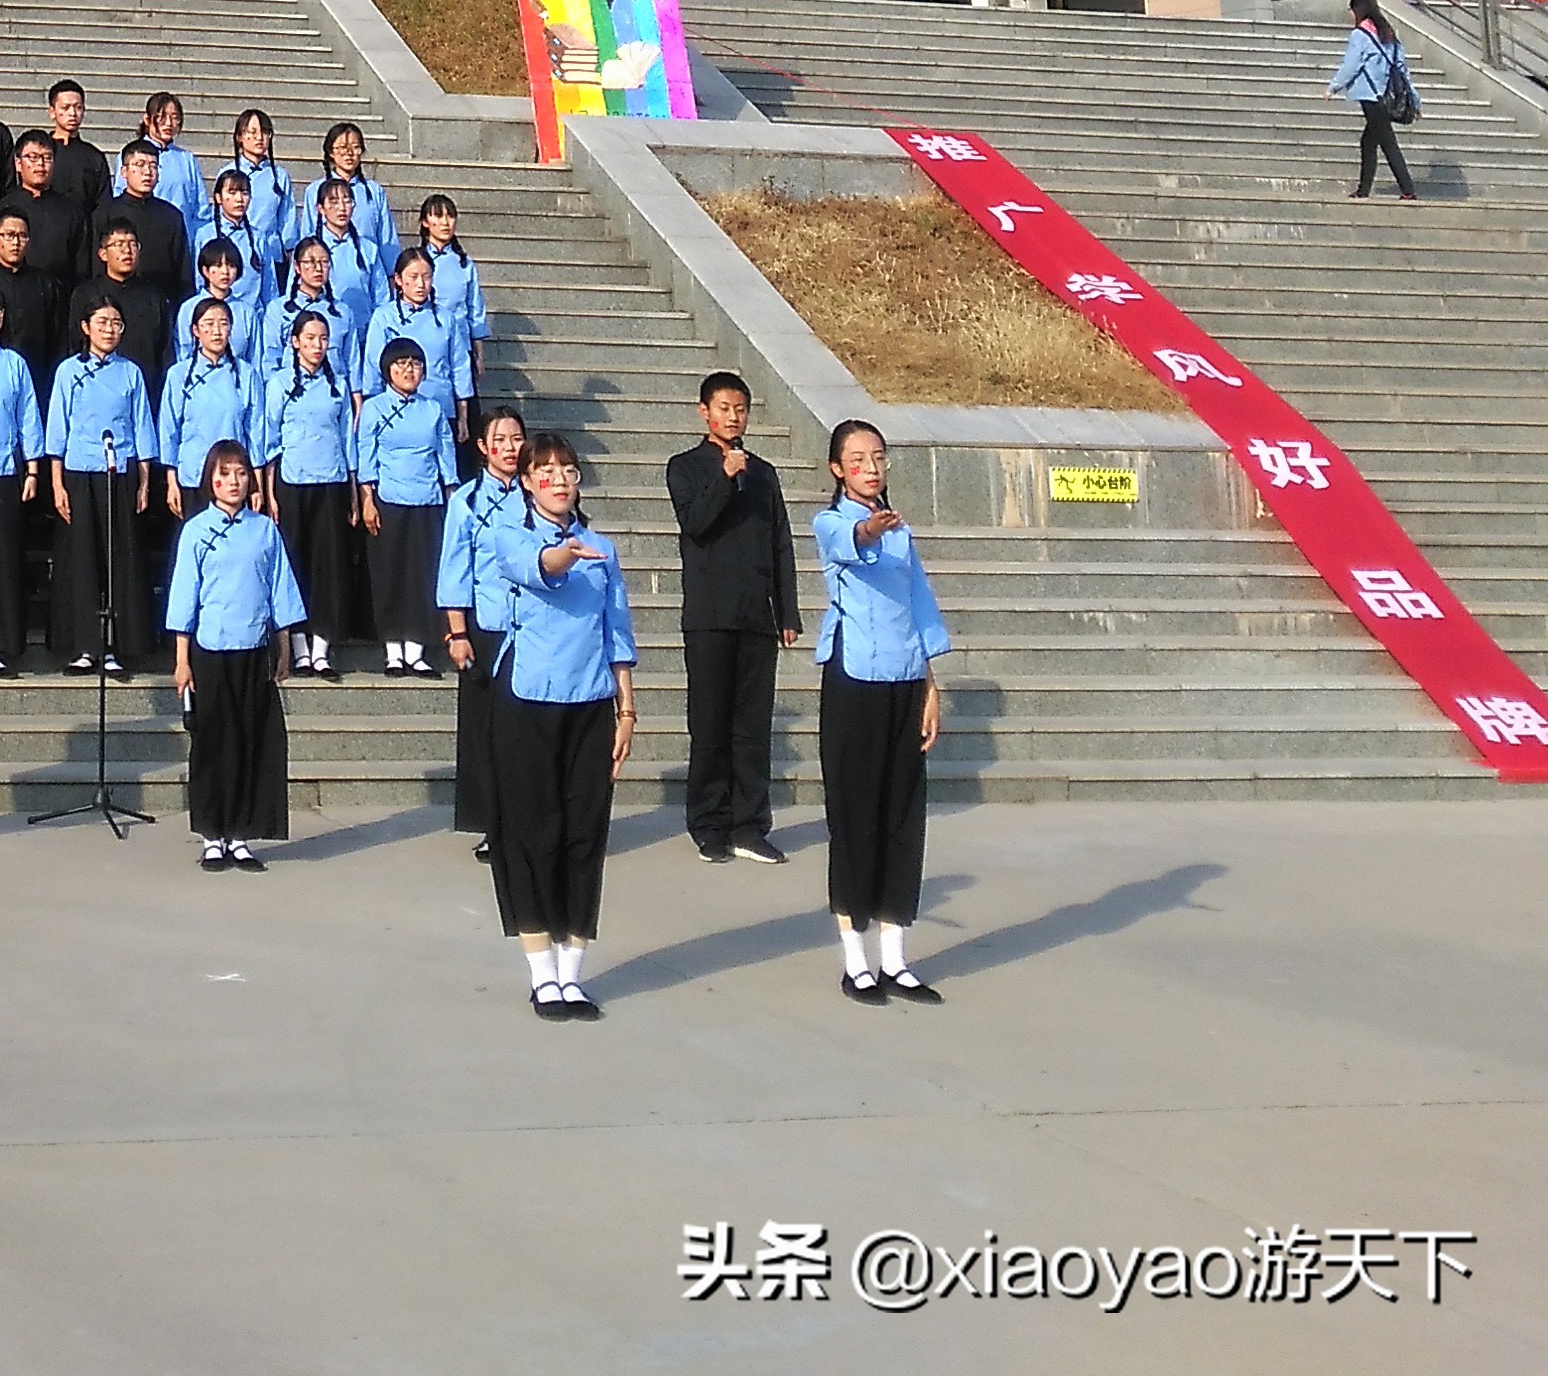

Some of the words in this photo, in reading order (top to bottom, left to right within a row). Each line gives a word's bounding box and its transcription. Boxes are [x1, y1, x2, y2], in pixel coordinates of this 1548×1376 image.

[907, 132, 1548, 746] 推广学风好品牌
[1082, 474, 1132, 491] 小心台阶
